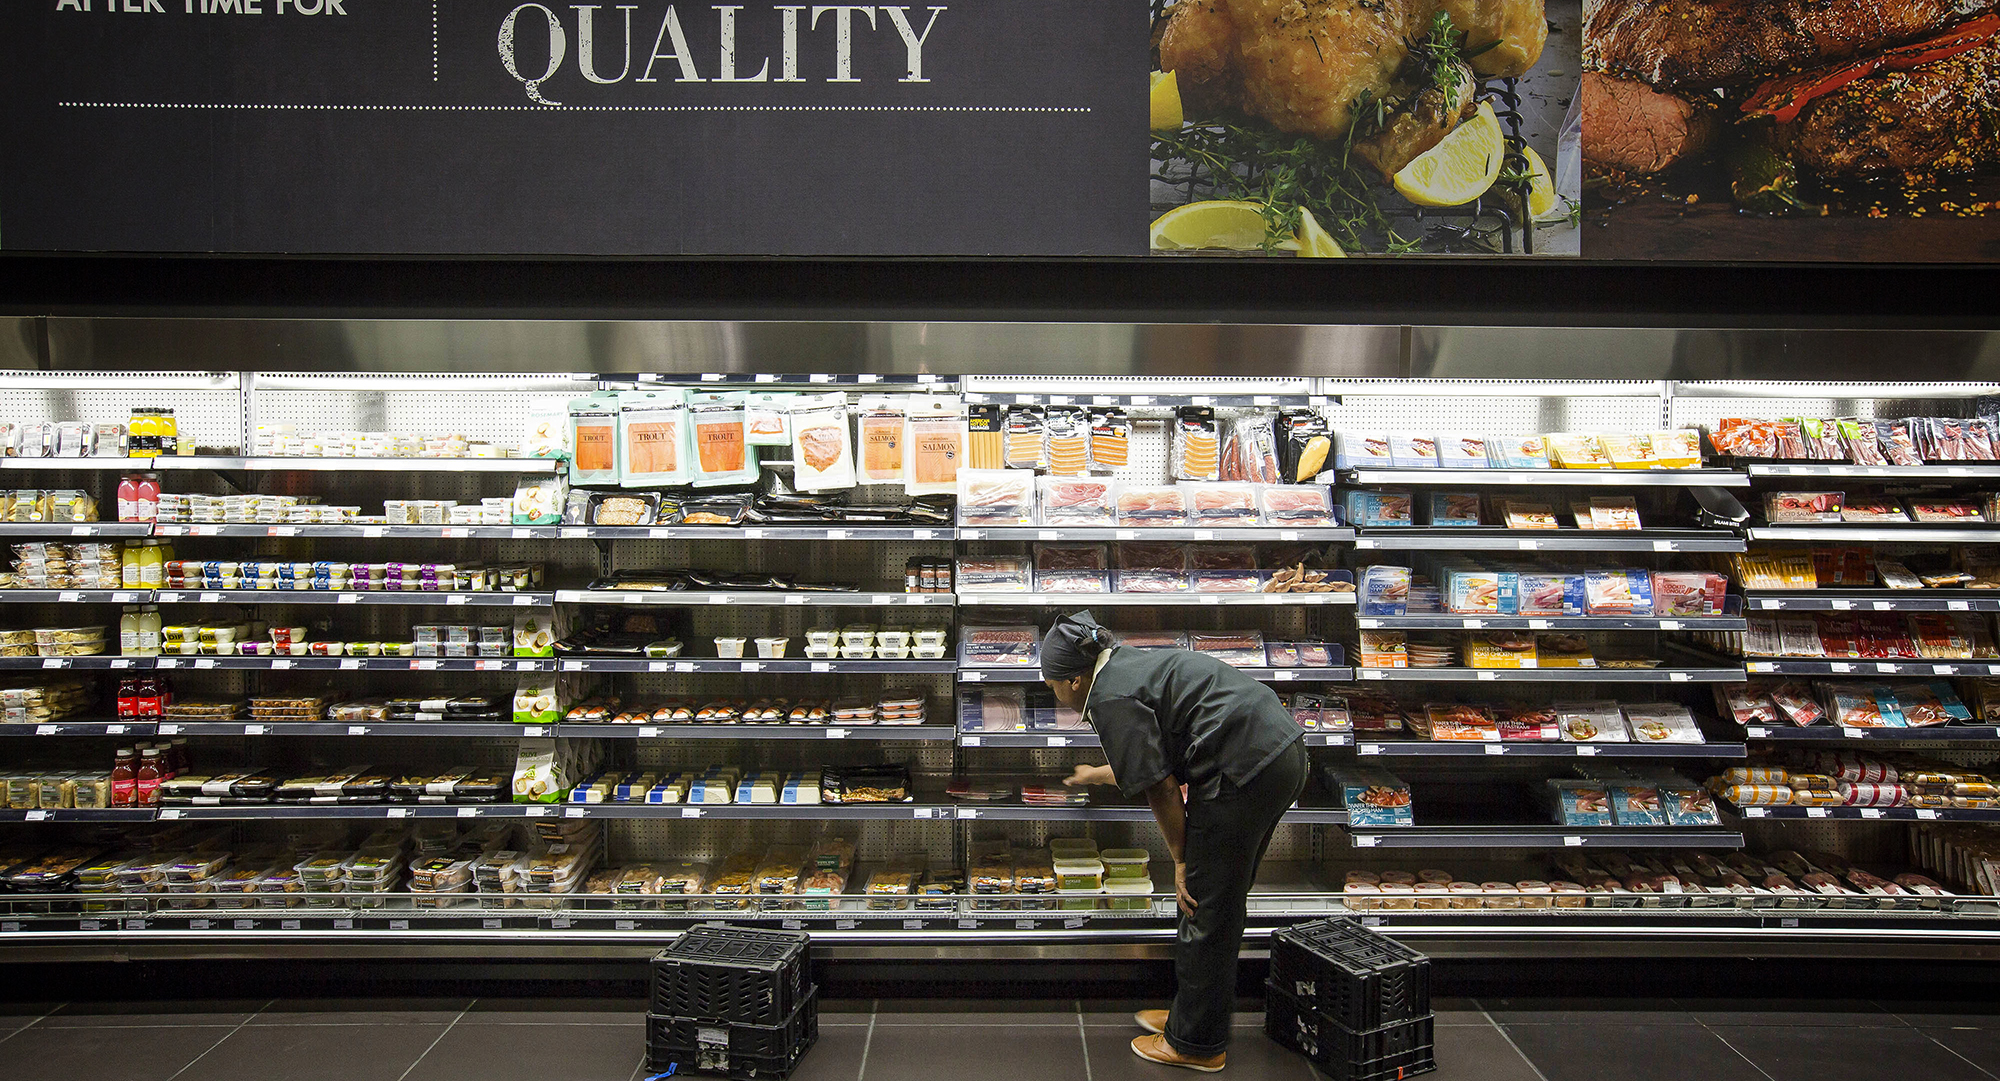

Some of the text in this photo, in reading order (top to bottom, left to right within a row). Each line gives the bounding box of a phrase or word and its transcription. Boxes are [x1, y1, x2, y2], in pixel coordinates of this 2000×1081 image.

[498, 2, 947, 106] QUALITY
[637, 432, 667, 442] TROUT
[707, 432, 735, 442] TROUT
[922, 443, 956, 451] SALMON
